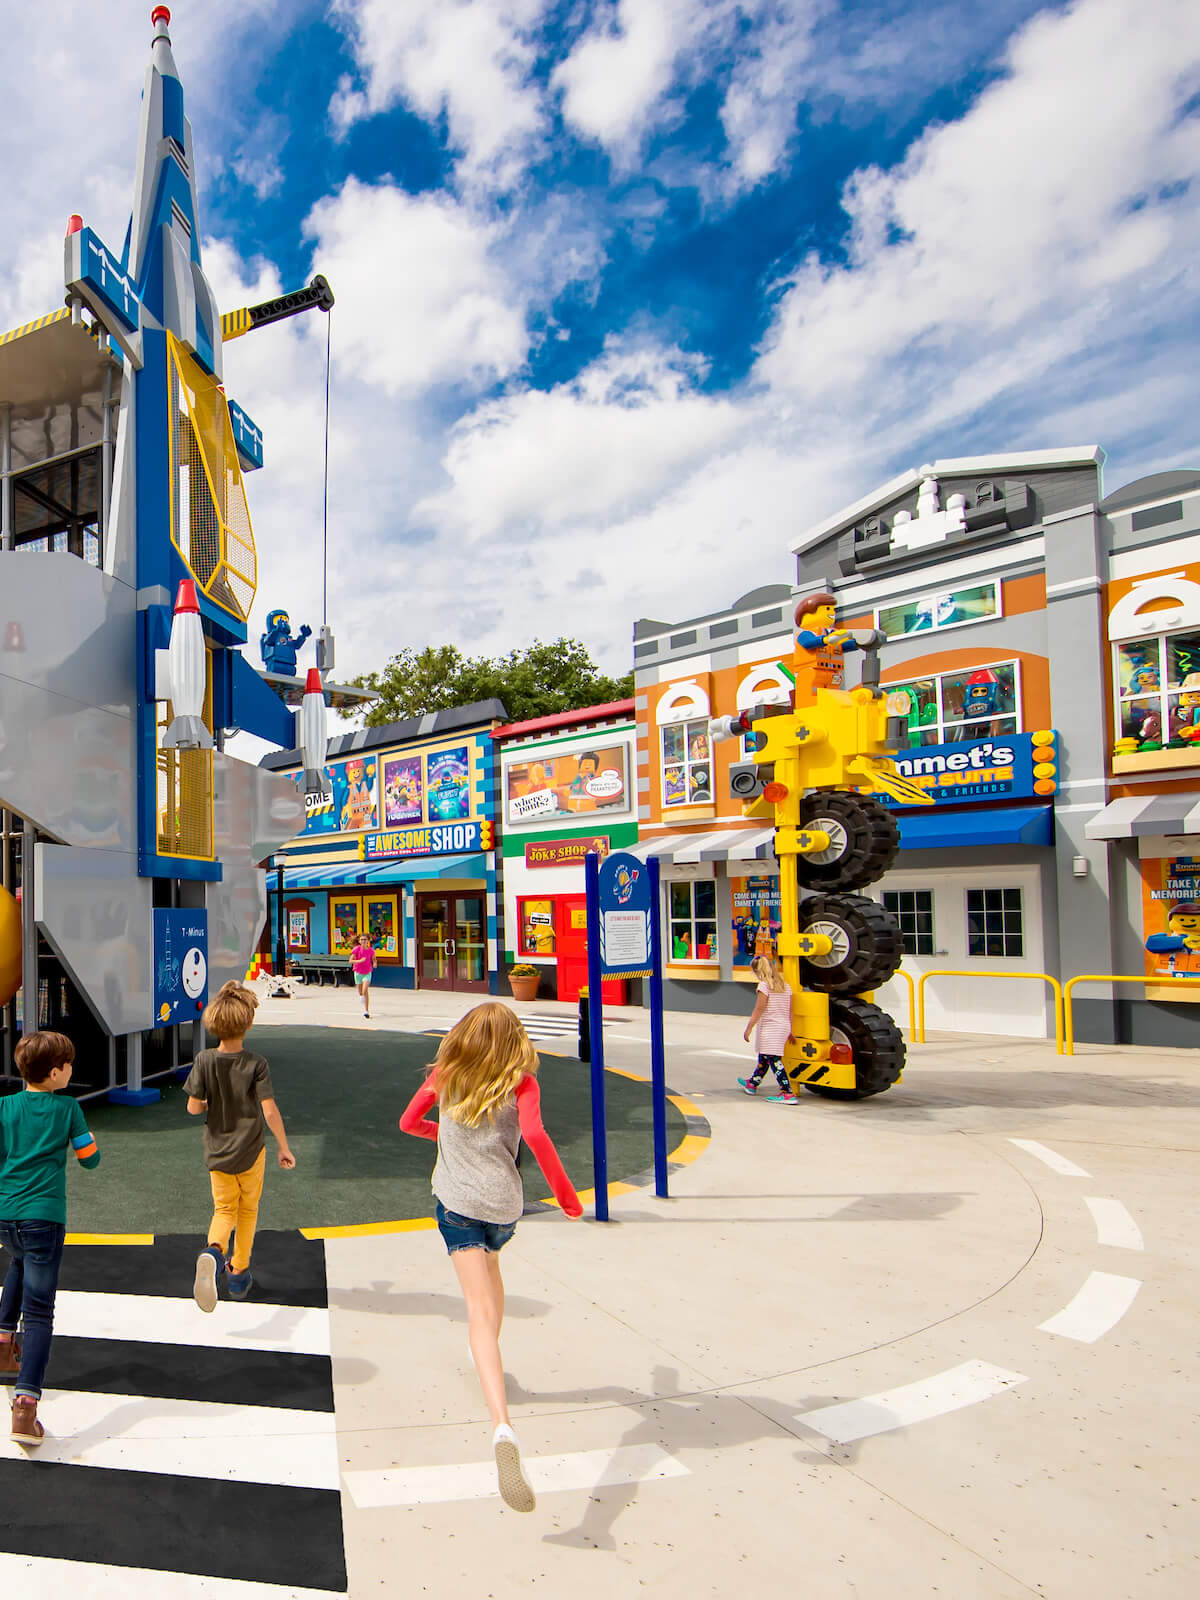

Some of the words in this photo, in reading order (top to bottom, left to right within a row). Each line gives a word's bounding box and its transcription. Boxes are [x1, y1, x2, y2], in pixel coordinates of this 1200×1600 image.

[894, 743, 1015, 777] mmet's
[939, 765, 1014, 786] SUITE
[941, 788, 948, 797] &
[955, 784, 1006, 796] FRIENDS
[305, 791, 330, 807] OME
[514, 795, 545, 808] where
[519, 797, 549, 815] pants?
[367, 836, 376, 852] THE
[375, 829, 432, 851] AWESOME
[432, 824, 476, 851] SHOP
[529, 849, 557, 861] JOKE
[558, 845, 587, 858] SHOP
[1166, 879, 1191, 889] TAKE
[1151, 889, 1200, 899] MEMORIE
[182, 927, 205, 937] T-Minus
